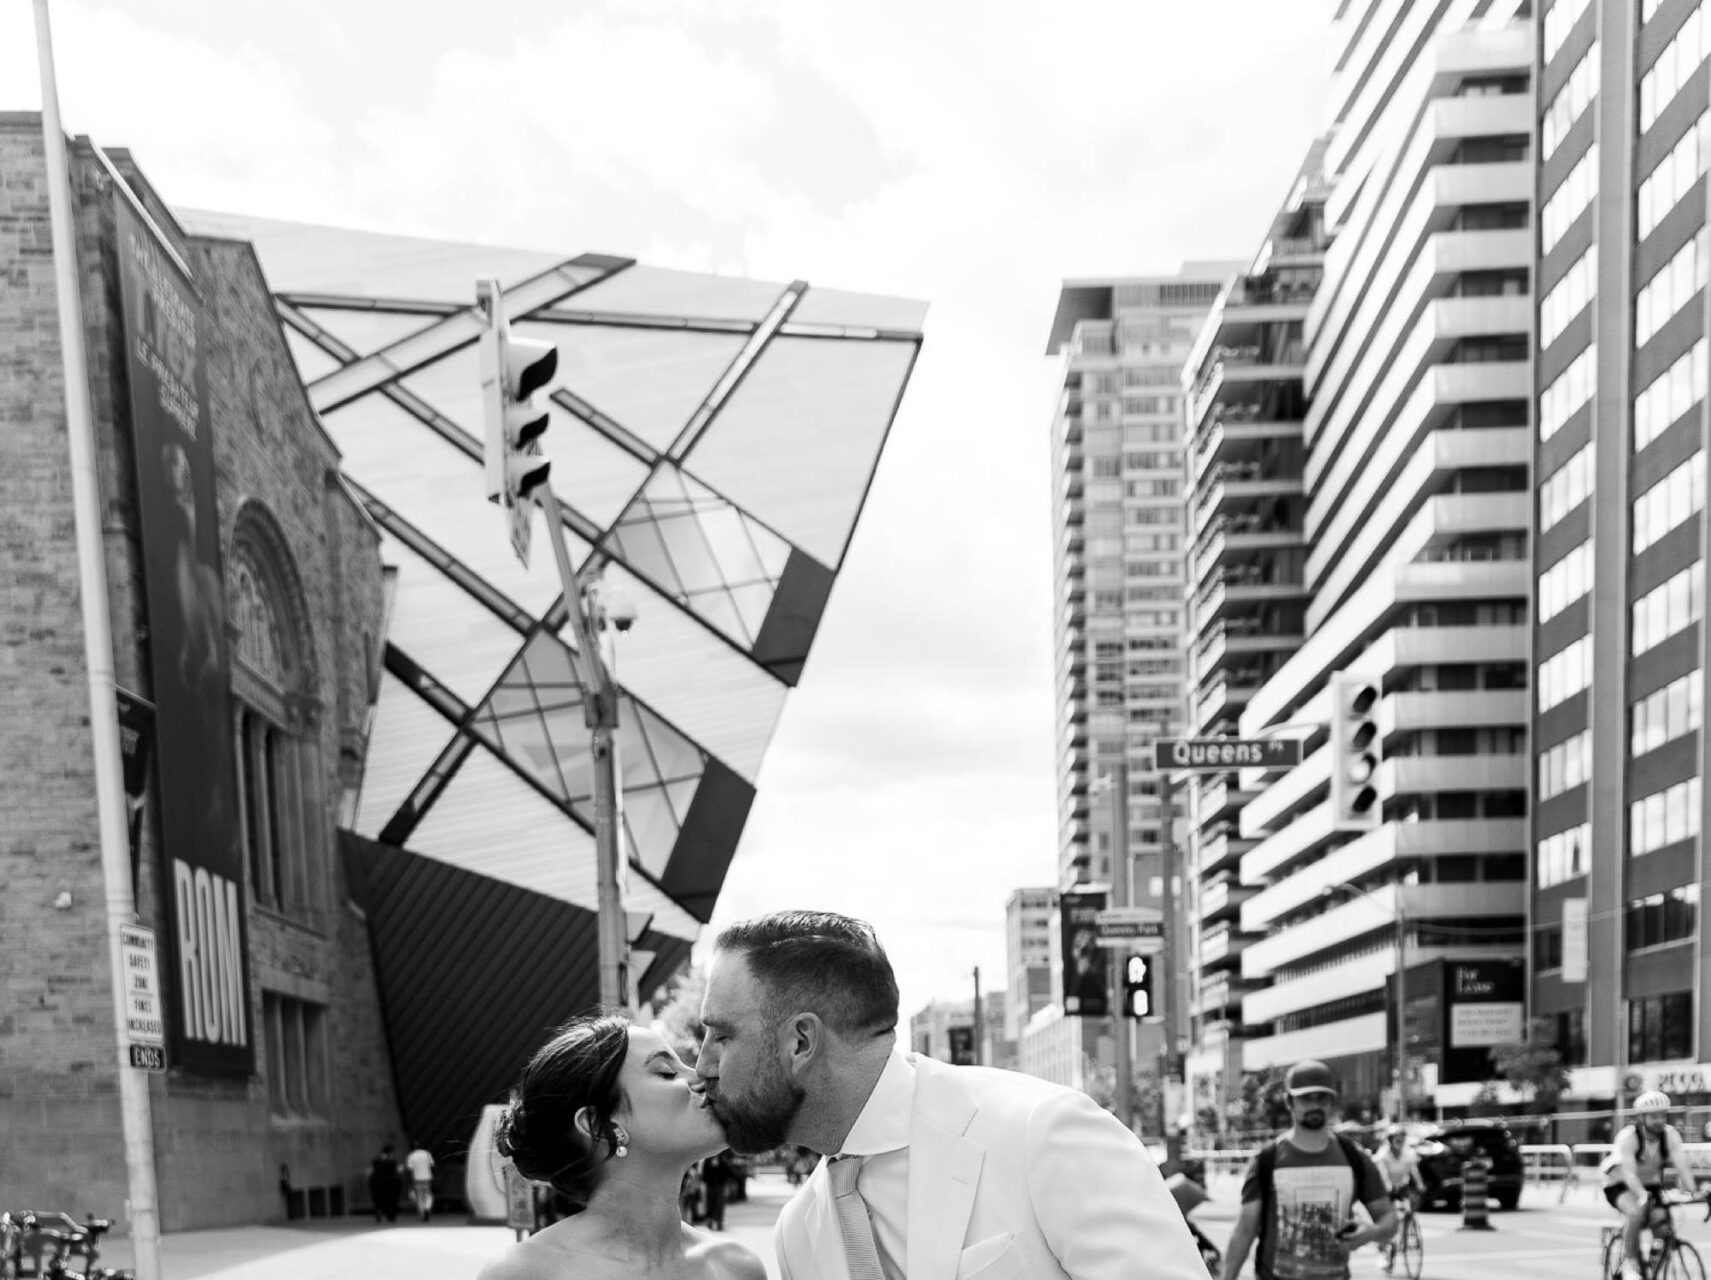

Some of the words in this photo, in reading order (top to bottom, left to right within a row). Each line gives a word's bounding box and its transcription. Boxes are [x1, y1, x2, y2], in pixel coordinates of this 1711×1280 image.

[1172, 741, 1263, 766] Queens
[173, 857, 247, 1048] ROM
[129, 954, 151, 970] SAFETY
[133, 974, 149, 990] ZONE
[134, 999, 152, 1014] FINES
[128, 1017, 163, 1034] INCREASED
[135, 1047, 162, 1069] ENDS
